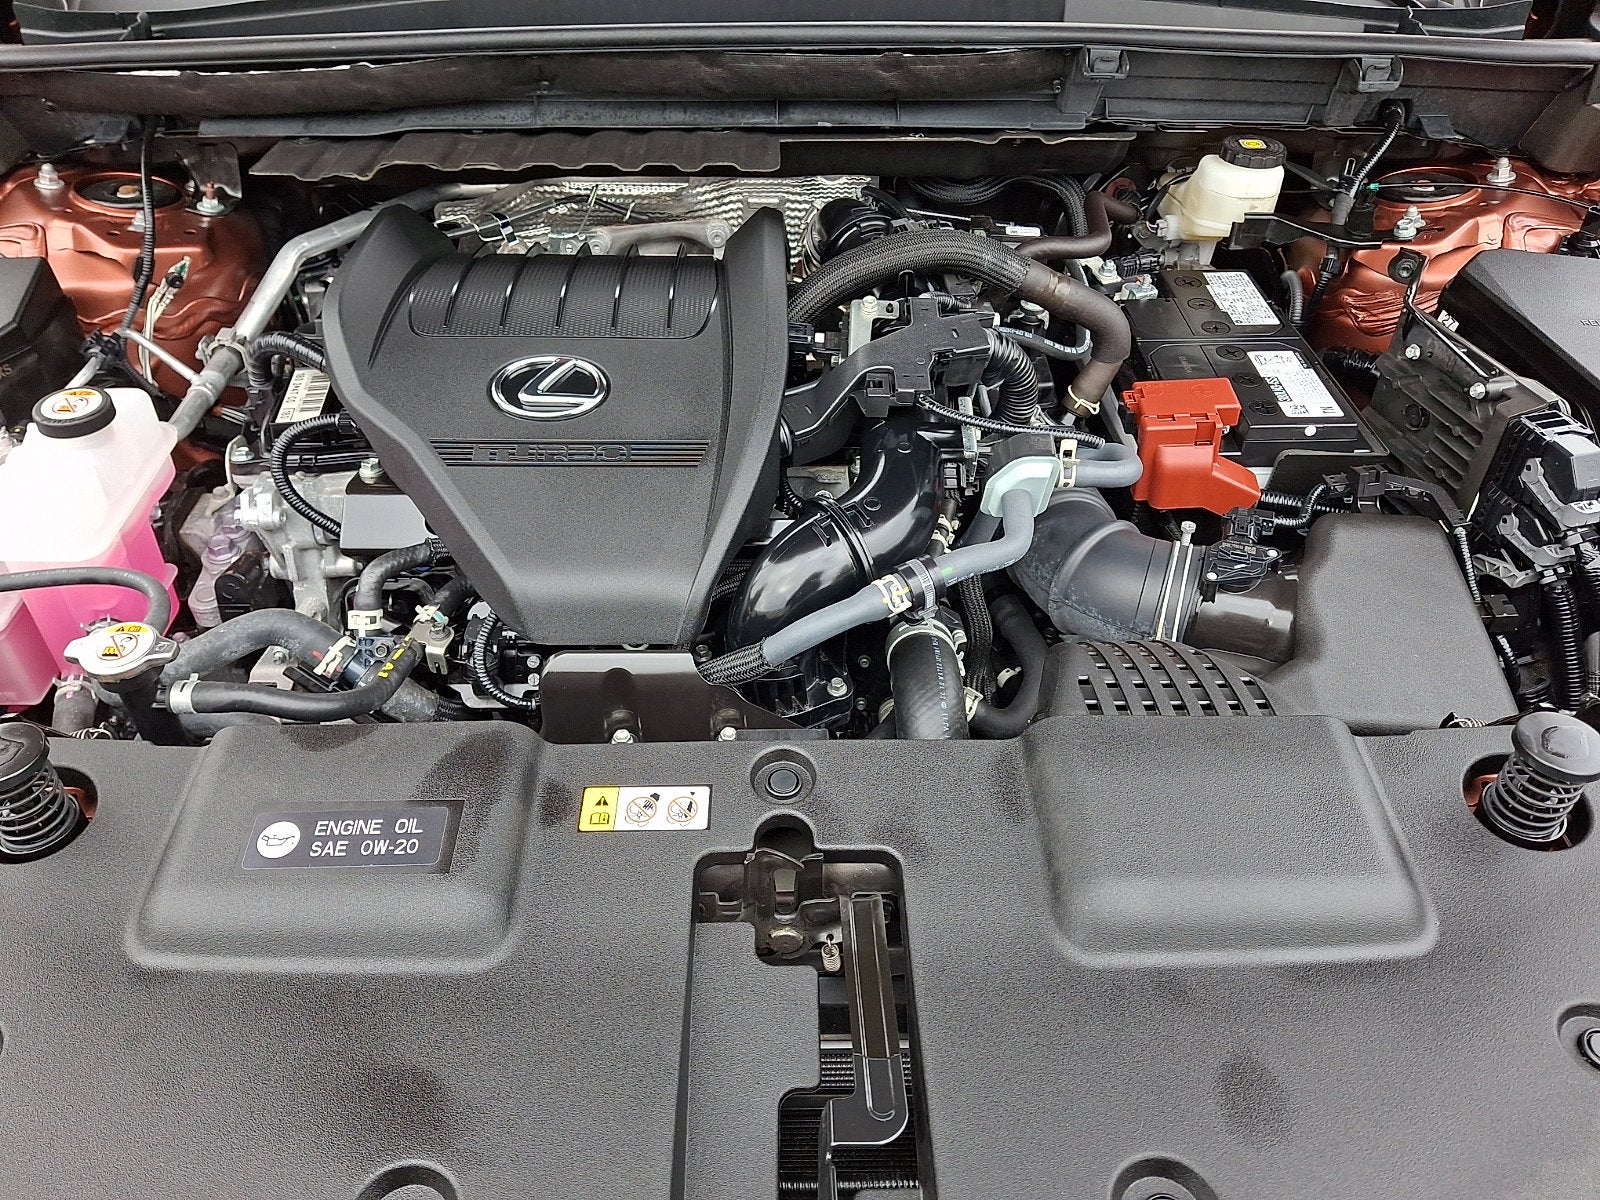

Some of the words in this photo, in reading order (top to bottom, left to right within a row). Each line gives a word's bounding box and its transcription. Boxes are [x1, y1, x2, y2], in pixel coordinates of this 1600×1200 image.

[1442, 313, 1456, 328] 27
[475, 444, 628, 461] TURBO
[314, 819, 383, 836] ENGINE
[394, 818, 423, 834] OIL
[309, 840, 349, 857] SAE
[360, 839, 419, 856] 0W-20
